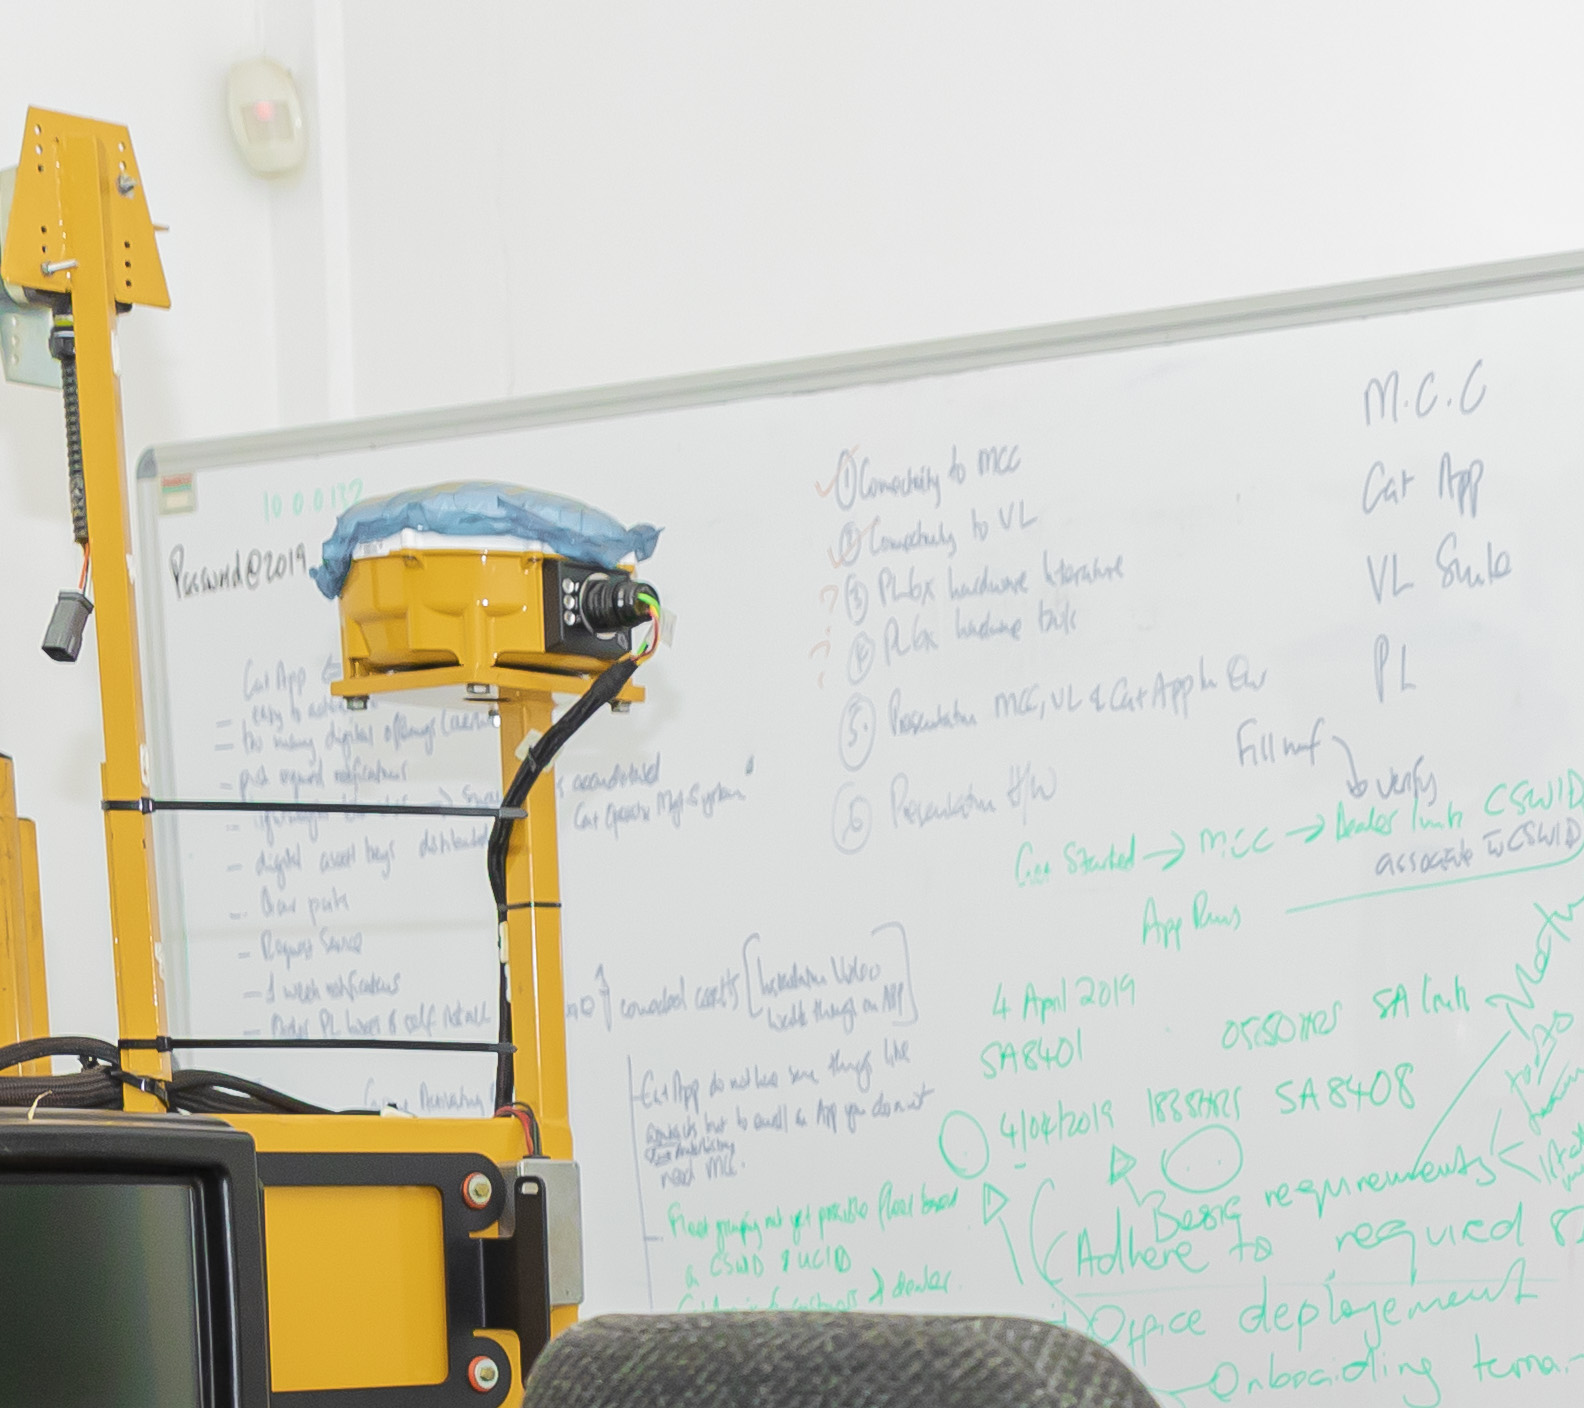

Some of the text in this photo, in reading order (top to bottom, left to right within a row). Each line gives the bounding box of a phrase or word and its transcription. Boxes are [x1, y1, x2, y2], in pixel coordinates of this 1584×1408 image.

[947, 444, 967, 485] to
[1362, 451, 1484, 519] Cat App
[970, 507, 989, 542] to
[1367, 553, 1416, 604] VL
[1075, 973, 1137, 1009] 2019
